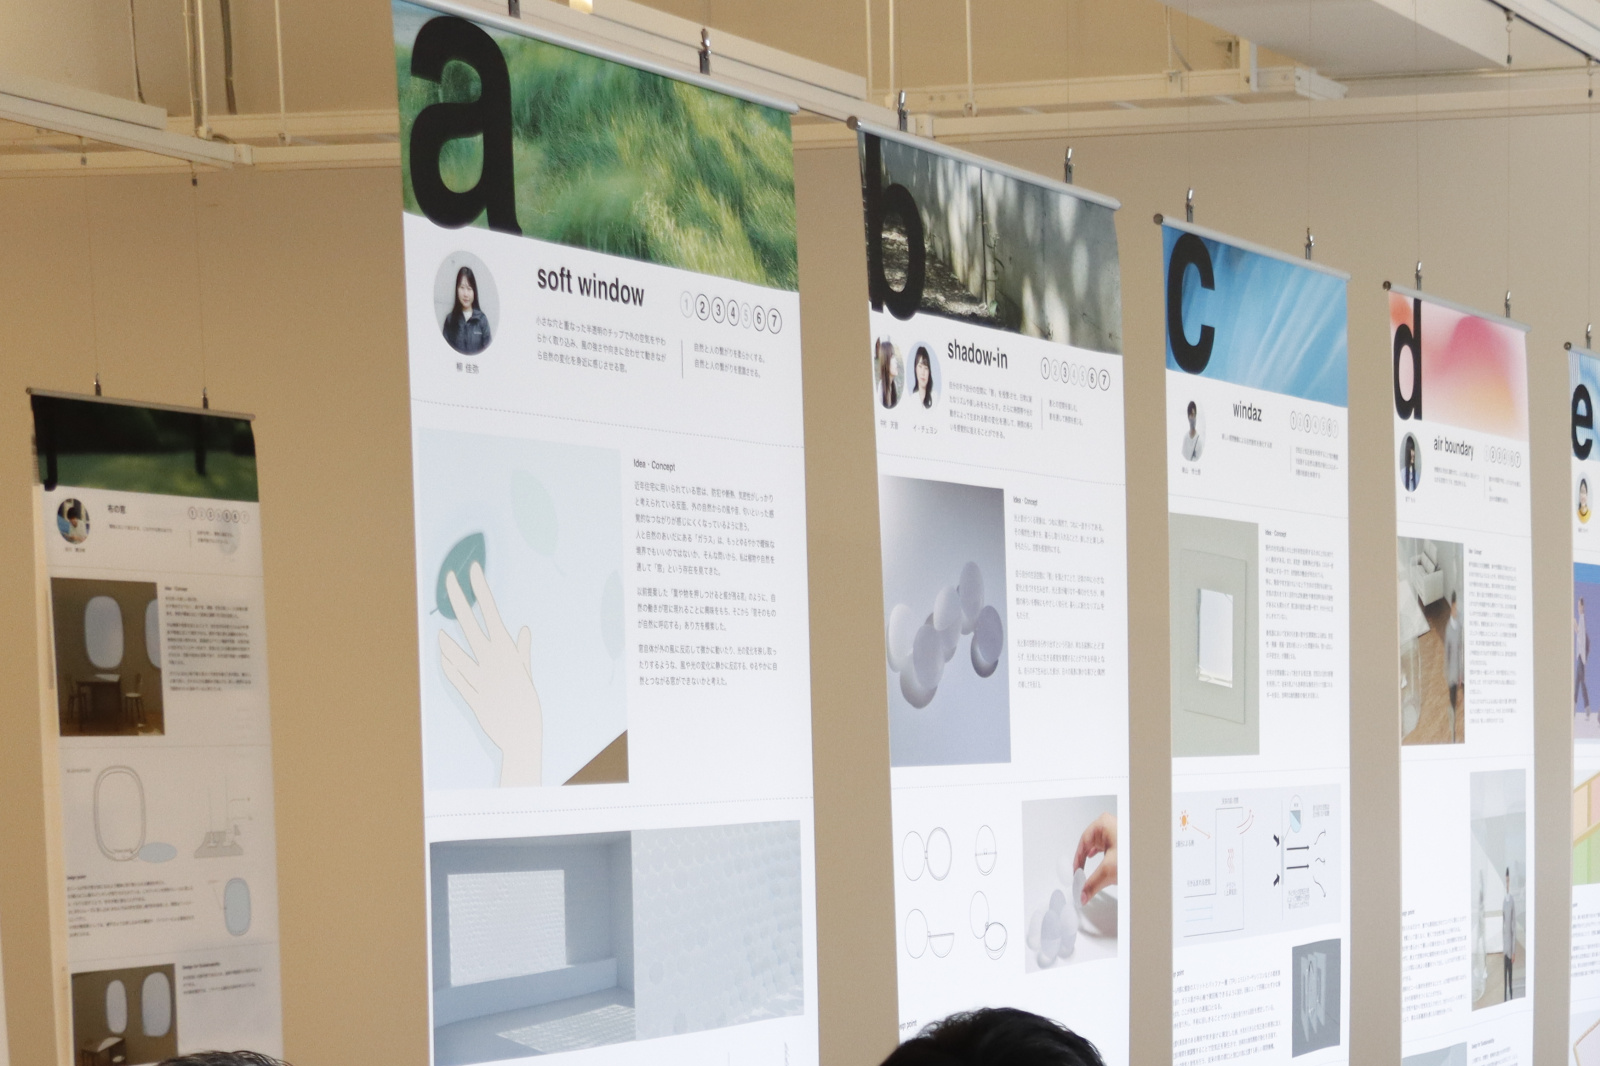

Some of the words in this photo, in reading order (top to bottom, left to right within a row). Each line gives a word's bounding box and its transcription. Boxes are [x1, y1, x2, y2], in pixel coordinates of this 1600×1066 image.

[409, 16, 522, 236] a
[865, 133, 926, 321] b
[537, 266, 573, 297] soft
[578, 273, 645, 307] window
[1167, 232, 1215, 374] c
[948, 338, 1008, 370] shadow-in
[1394, 298, 1422, 421] d
[1233, 401, 1262, 422] windaz
[1572, 384, 1593, 460] e
[633, 459, 646, 469] Idea
[652, 460, 676, 472] Concept
[1434, 436, 1443, 451] air
[1445, 436, 1474, 461] boundary
